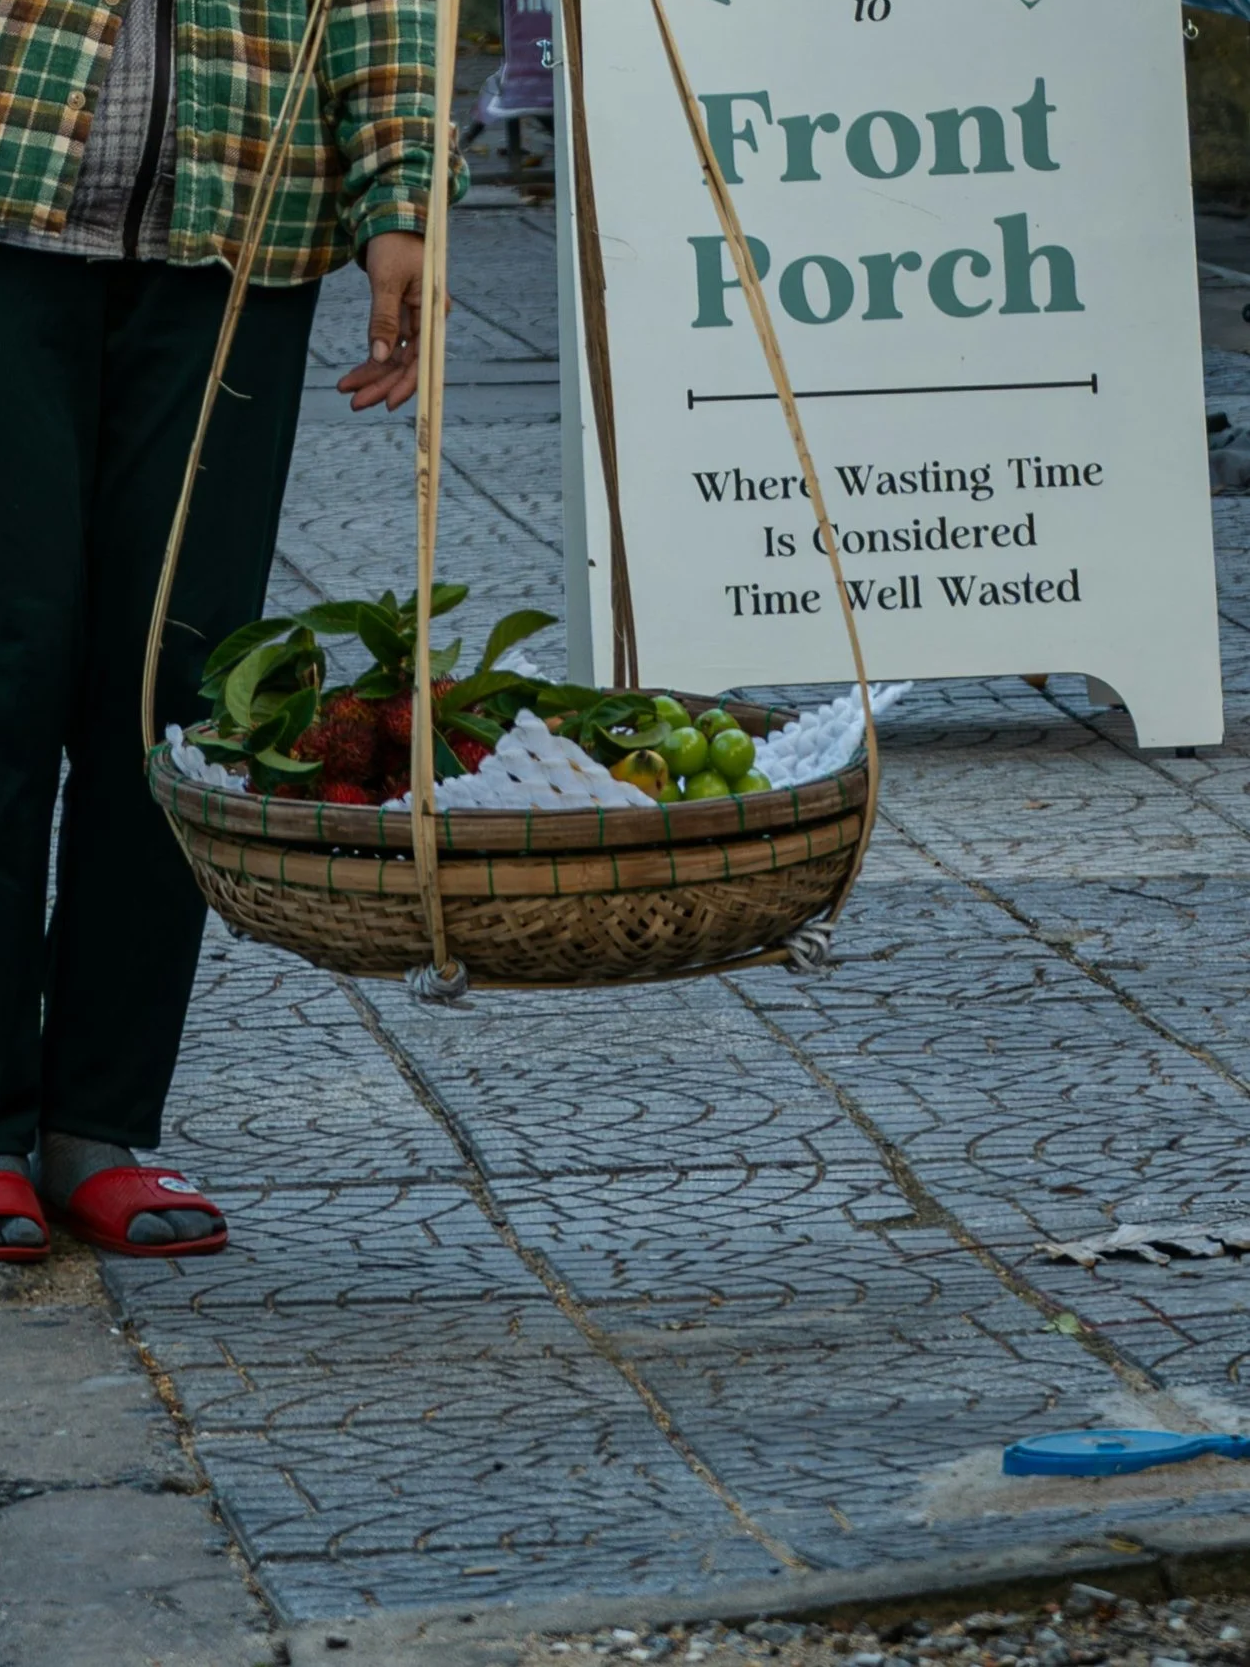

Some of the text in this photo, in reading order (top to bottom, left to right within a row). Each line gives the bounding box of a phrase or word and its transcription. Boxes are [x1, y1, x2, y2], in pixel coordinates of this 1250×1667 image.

[697, 77, 1061, 186] Front
[687, 212, 1086, 328] Porch
[834, 460, 995, 502] Wasting
[1006, 456, 1104, 490] Time
[763, 513, 1038, 558] Is Considered
[725, 568, 1083, 617] Time Well Wasted
